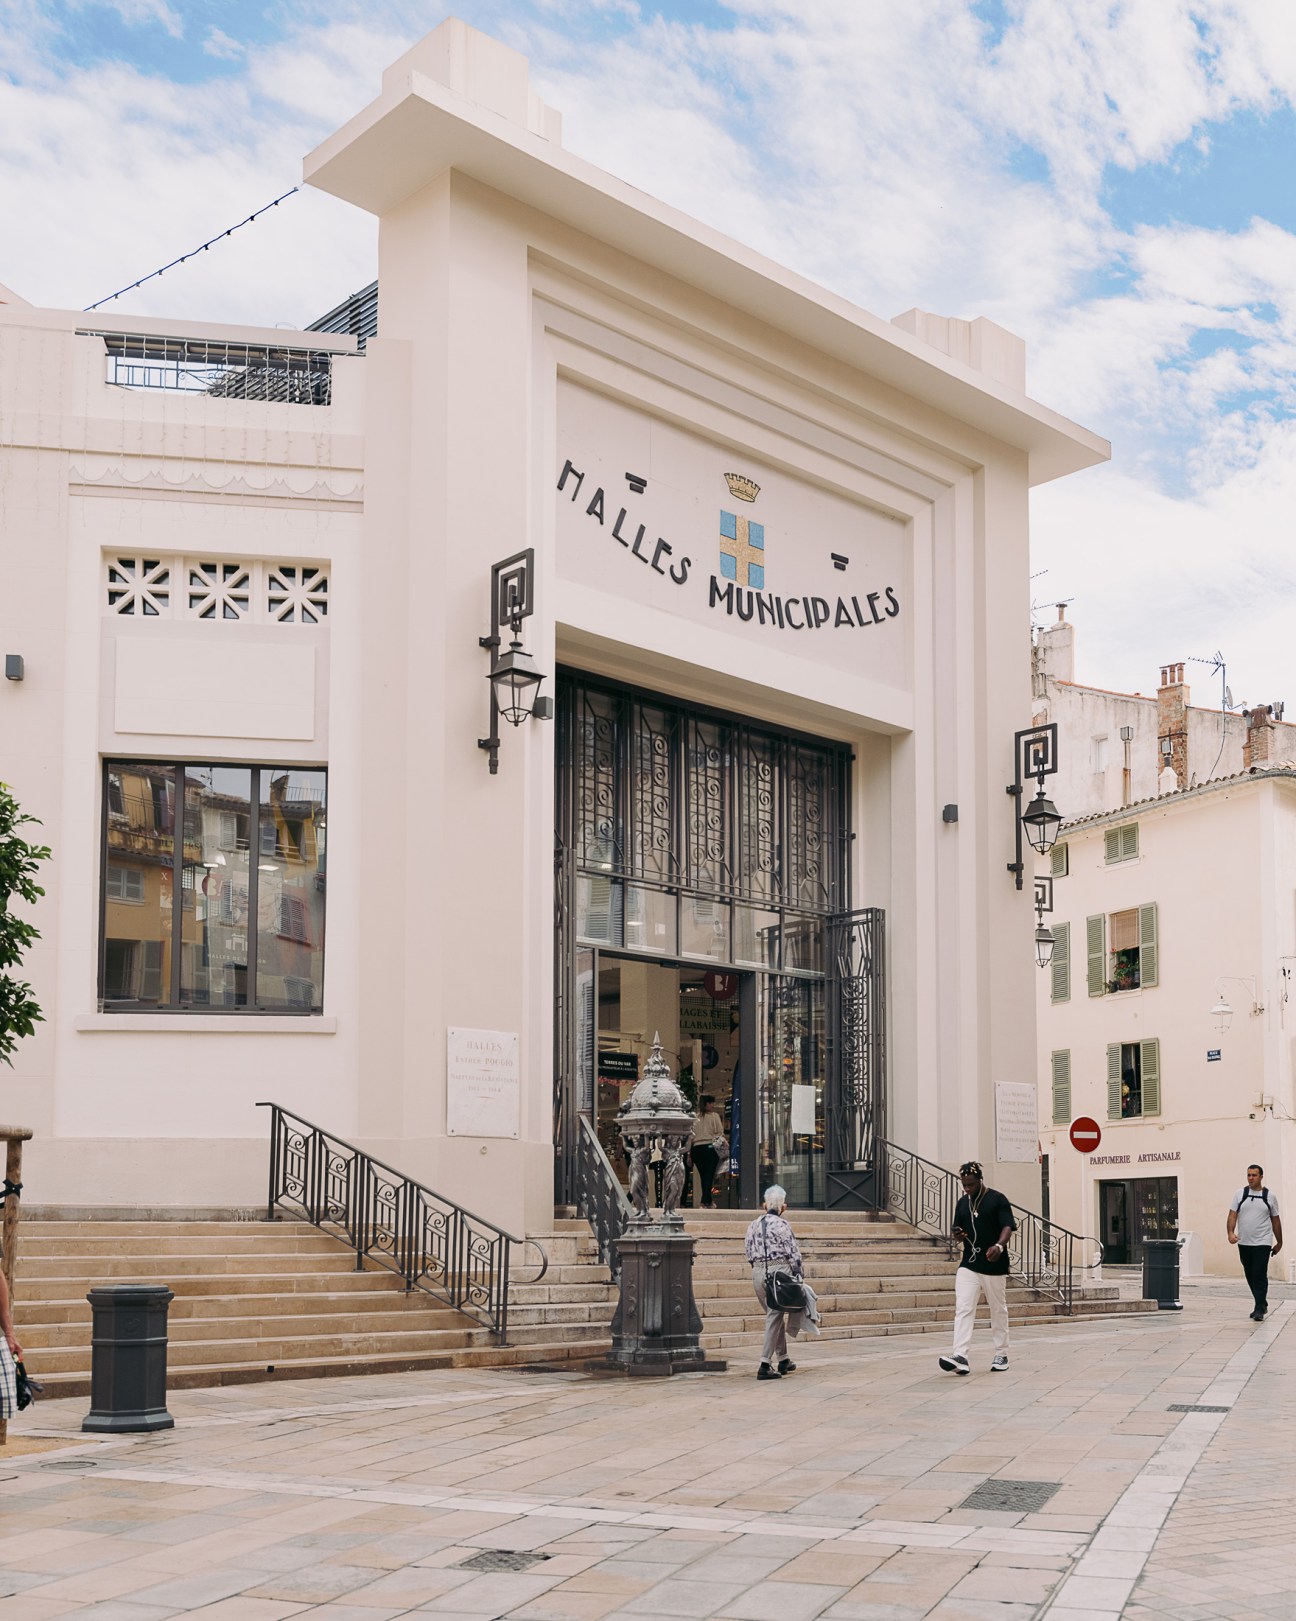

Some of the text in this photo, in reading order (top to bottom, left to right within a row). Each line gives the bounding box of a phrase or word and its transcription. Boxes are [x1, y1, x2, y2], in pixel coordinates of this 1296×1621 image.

[557, 459, 900, 630] HALLES MUNICIPALES
[466, 1040, 503, 1052] HALLES
[1089, 1151, 1181, 1165] PARFUMERIE ARTISANALE
